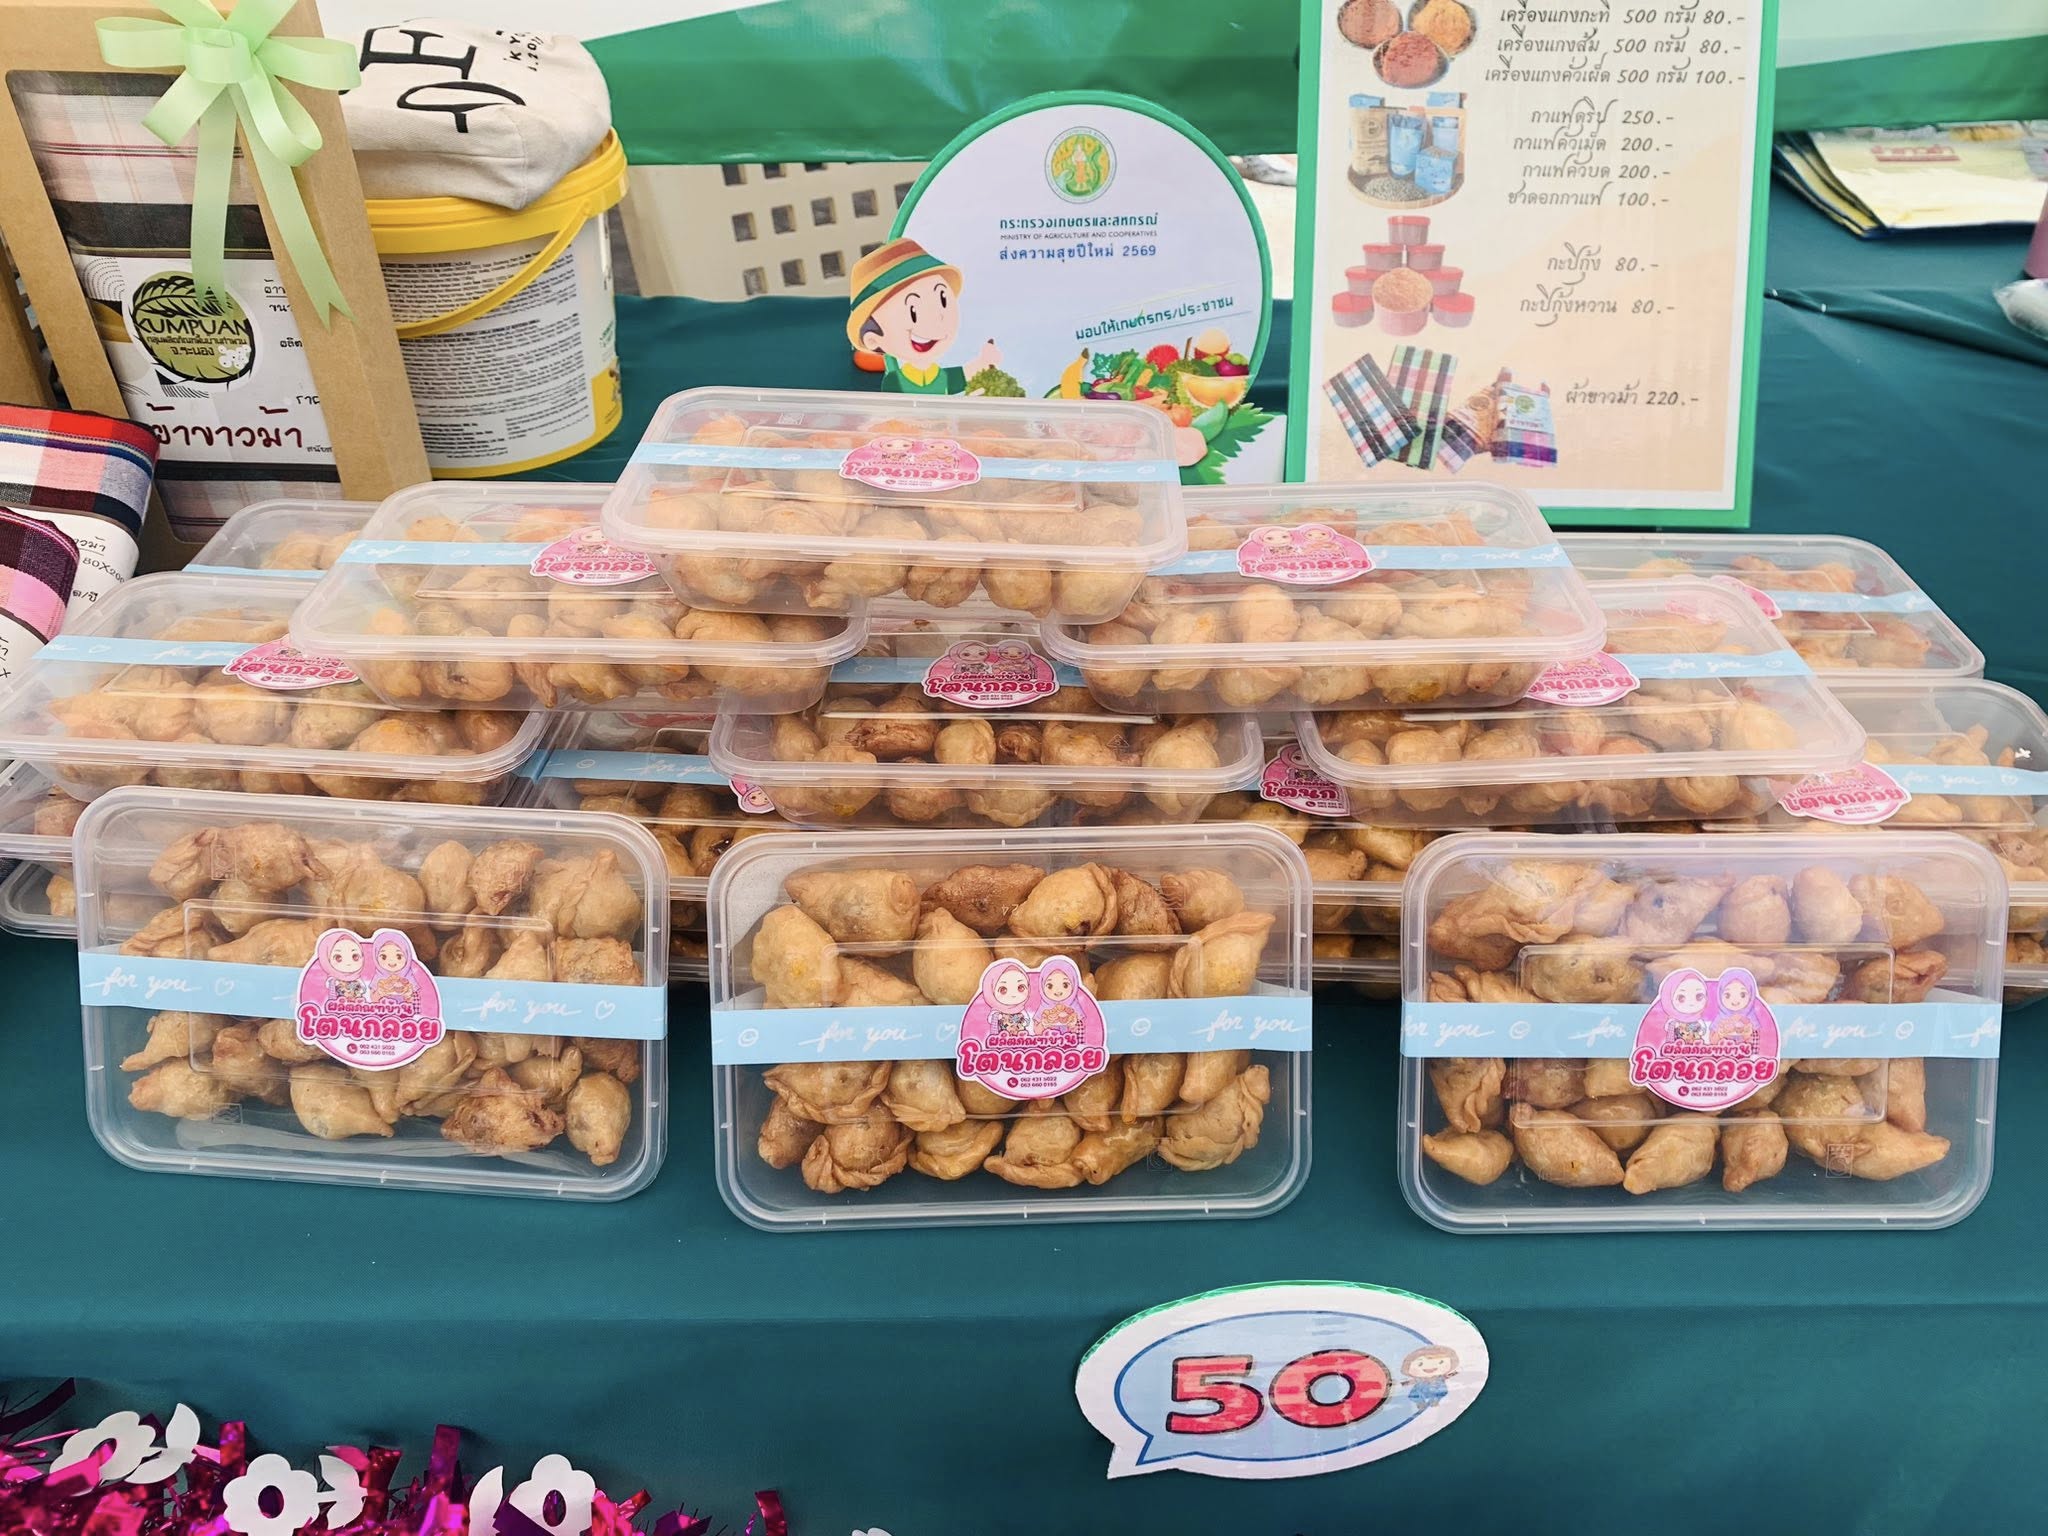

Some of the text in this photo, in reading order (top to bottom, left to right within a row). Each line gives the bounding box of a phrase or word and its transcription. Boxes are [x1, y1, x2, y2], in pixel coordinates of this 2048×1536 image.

[1623, 9, 1656, 24] 500
[1663, 0, 1700, 24] กรัม
[1703, 11, 1745, 25] 80.-
[1497, 24, 1741, 54] เครื่องแกงส้ม 500 กรัม 80.-
[1617, 69, 1649, 84] 500
[1656, 57, 1690, 84] กรัม
[1696, 71, 1745, 85] 100.-
[1622, 110, 1674, 124] 250.-
[1621, 137, 1672, 151] 200.-
[1618, 165, 1671, 179] 200.-
[1618, 192, 1669, 206] 100.-
[1000, 213, 1158, 229] กระทรวงเกษตรและสหกรณ์
[1000, 233, 1031, 241] MINISTRY
[1044, 231, 1089, 239] AGRICULTURE
[1108, 230, 1157, 238] COOPERATIVES
[999, 242, 1156, 262] ส่งความสุขปีใหม่ 2569
[1547, 242, 1659, 285] กะปิกุ้ง 80.-
[1076, 296, 1234, 340] มอบให้เกษตรกร/ประชาชน
[1520, 284, 1675, 327] กะปิกุ้งหวาน 80.-
[137, 318, 249, 336] KUMPUAN
[1566, 377, 1699, 405] ผ้าขาวม้า 220.-
[845, 461, 976, 481] โตนกลอย
[1241, 558, 1370, 574] โตนกลอย
[928, 677, 1053, 694] โตนกลอย
[85, 966, 202, 999] for you
[462, 991, 582, 1024] for you
[300, 1005, 440, 1041] โตนกลอย
[799, 1021, 922, 1053] for you
[1190, 1009, 1311, 1042] for you
[1434, 1021, 1496, 1048] you
[1568, 1016, 1627, 1048] for
[1782, 1015, 1884, 1049] for you
[988, 1031, 1077, 1047] ผลิตภัณฑ์บ้าน
[960, 1042, 1103, 1073] โตนกลอย
[1634, 1050, 1775, 1081] โตนกลอย
[1166, 1349, 1392, 1435] 50
